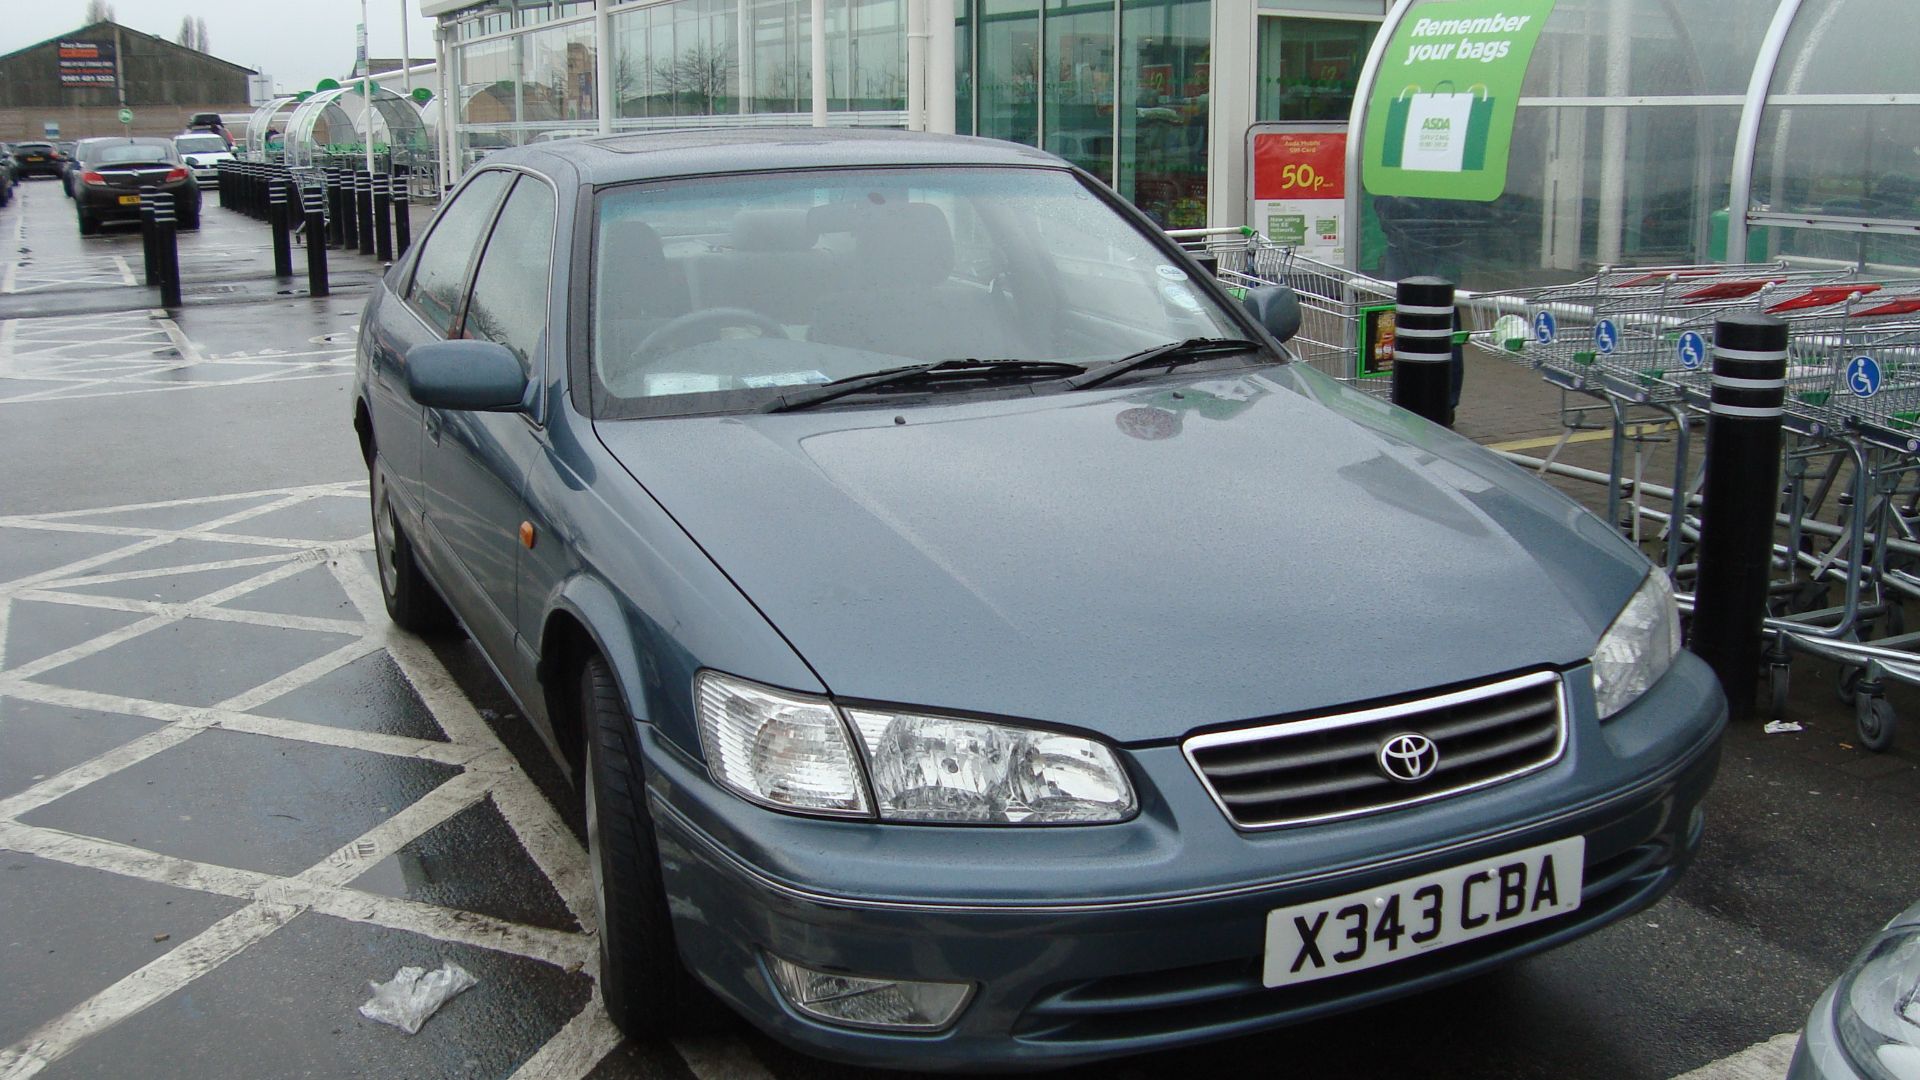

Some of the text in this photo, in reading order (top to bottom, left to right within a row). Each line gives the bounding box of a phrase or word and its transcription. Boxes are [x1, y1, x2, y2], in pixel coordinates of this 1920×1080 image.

[1411, 13, 1531, 37] Remember
[1404, 38, 1511, 65] your bags
[1422, 117, 1451, 130] ASDA
[1282, 163, 1325, 192] 50p
[1289, 854, 1559, 974] X343 CBA
